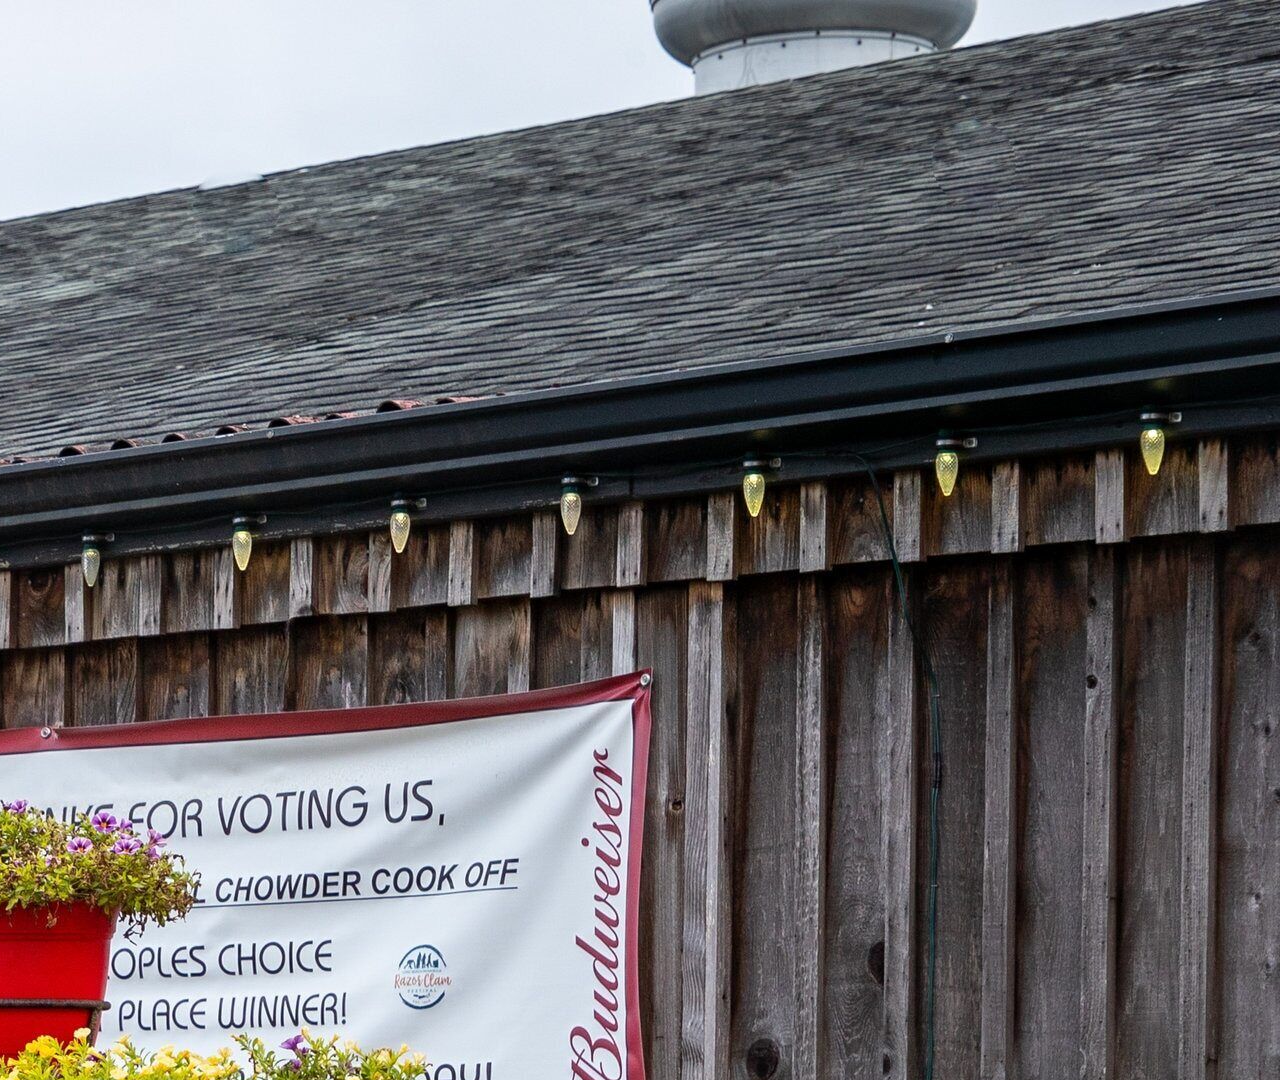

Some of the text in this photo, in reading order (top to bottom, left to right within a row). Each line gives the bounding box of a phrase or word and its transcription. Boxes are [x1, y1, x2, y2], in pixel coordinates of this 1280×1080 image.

[128, 798, 203, 839] FOR
[217, 784, 367, 836] VOTING
[384, 779, 445, 827] US,
[215, 870, 361, 904] CHOWDER
[371, 863, 459, 895] COOK
[464, 858, 519, 888] OFF
[107, 938, 333, 980] OPLES CHOICE
[394, 973, 452, 989] Razor Clam
[118, 991, 348, 1032] PLACE WINNER!
